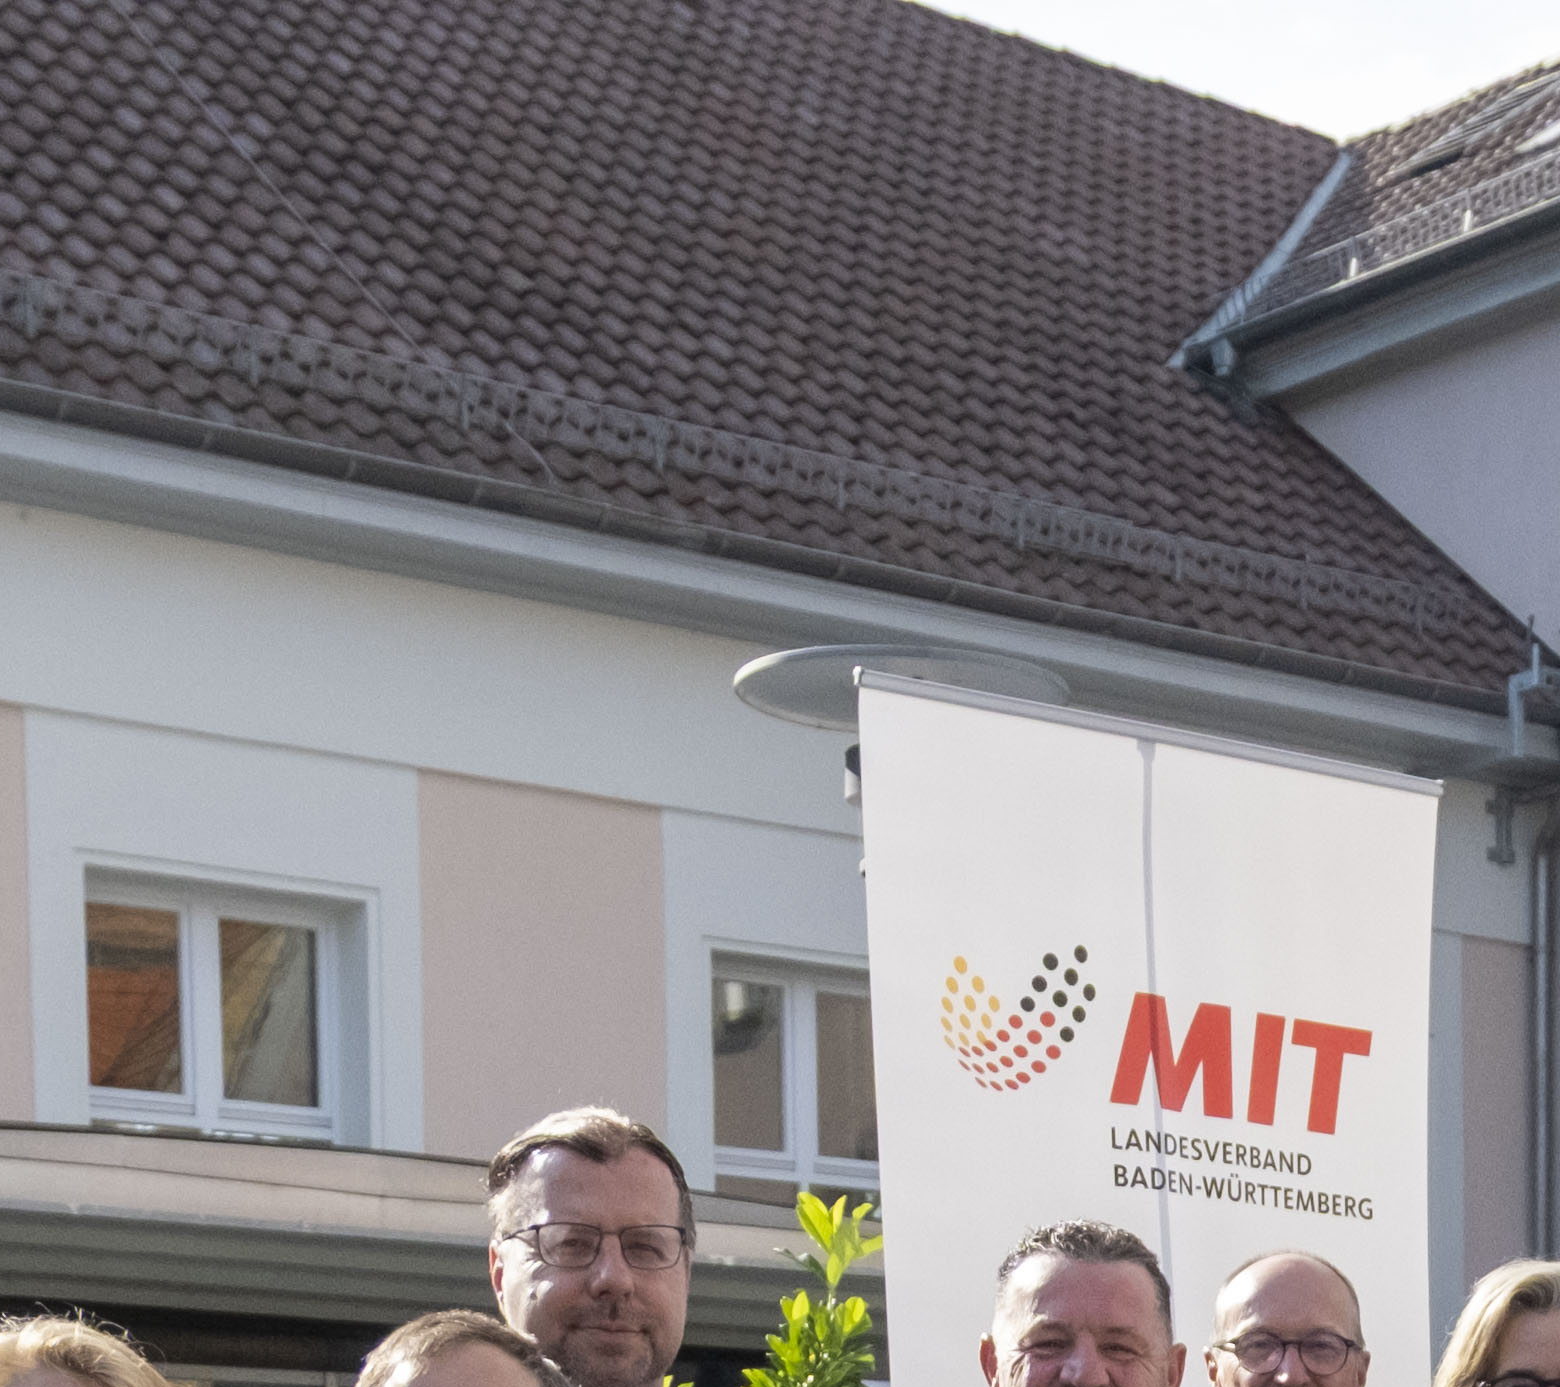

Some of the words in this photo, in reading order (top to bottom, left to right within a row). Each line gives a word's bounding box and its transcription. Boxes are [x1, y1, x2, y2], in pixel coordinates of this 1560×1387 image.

[1110, 992, 1372, 1135] MIT
[1111, 1127, 1312, 1176] LANDESVERBAND
[1113, 1164, 1374, 1220] BADEN-WÜRTTEMBERG
